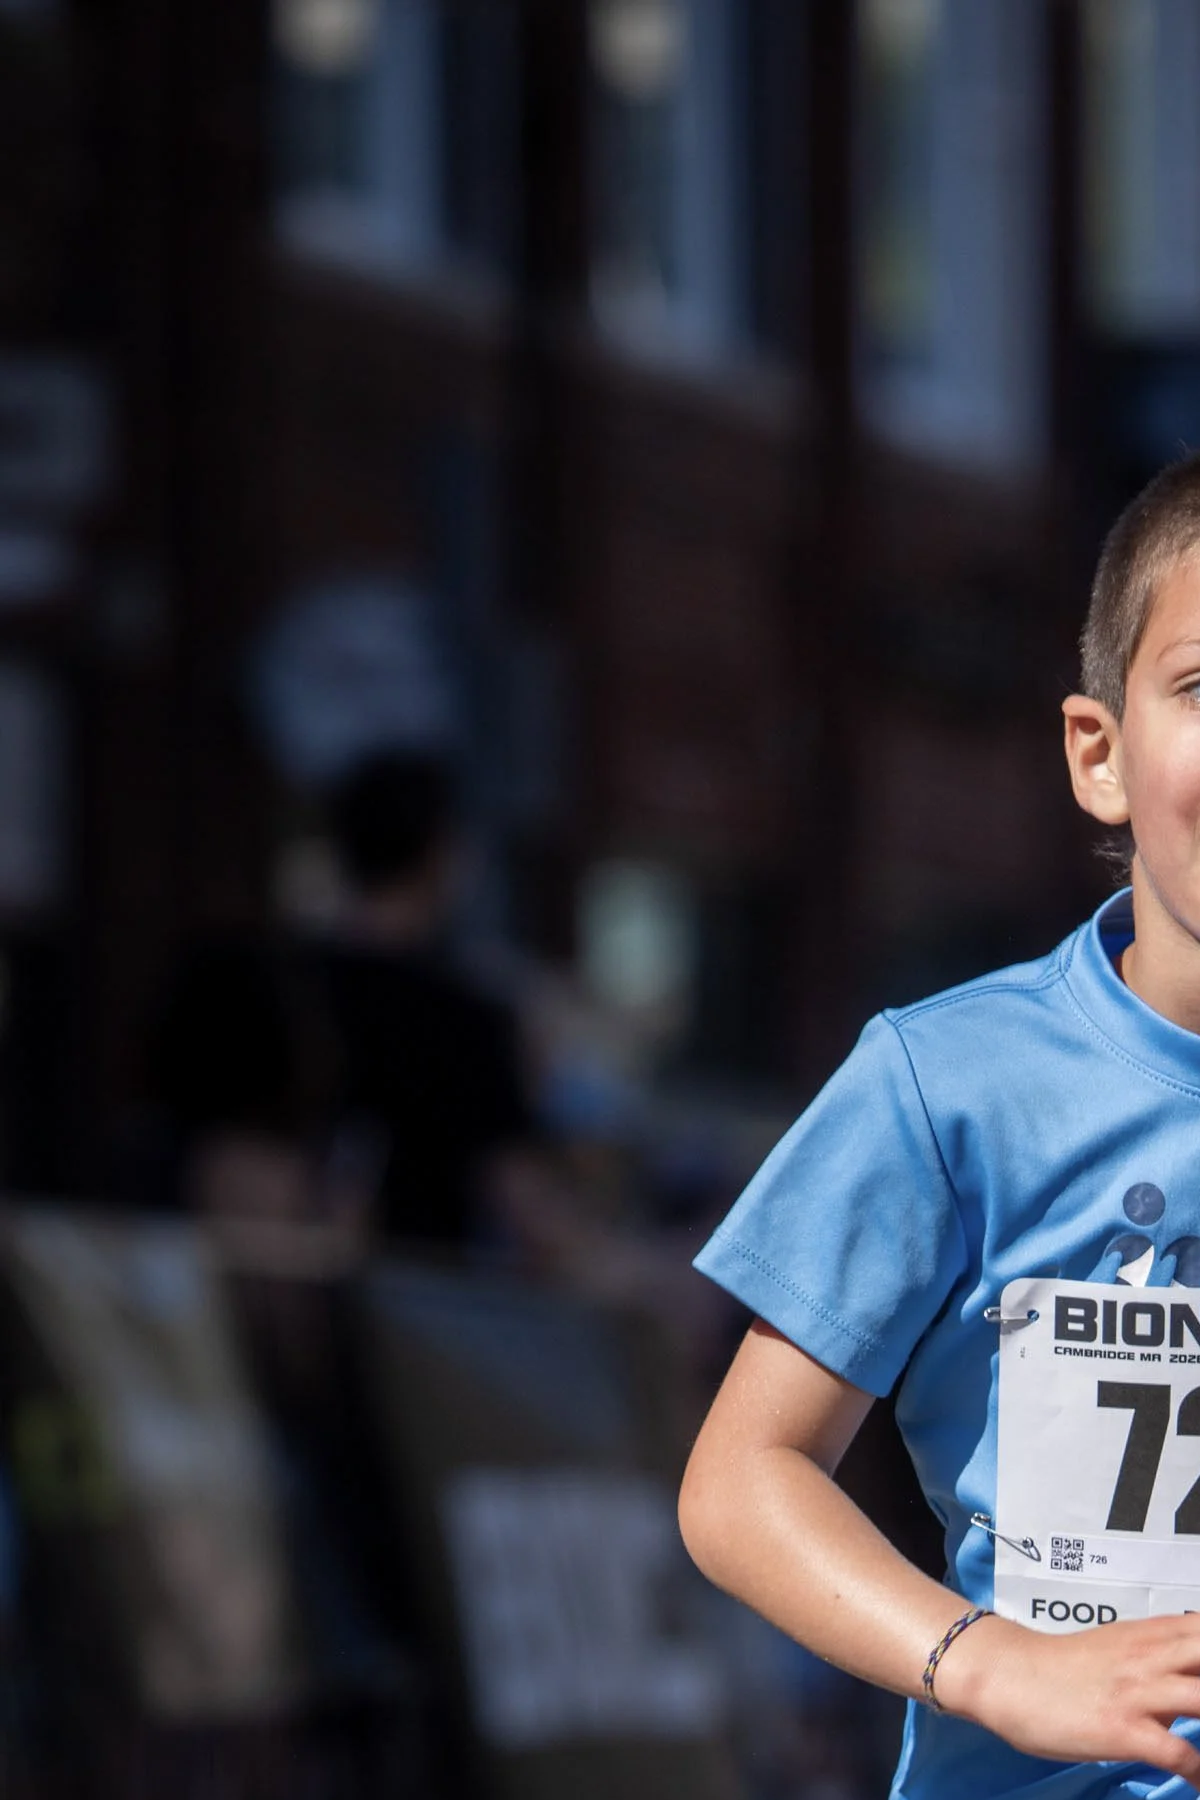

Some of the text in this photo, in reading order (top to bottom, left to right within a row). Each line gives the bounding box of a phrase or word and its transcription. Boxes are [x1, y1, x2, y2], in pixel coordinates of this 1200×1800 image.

[1054, 1346, 1136, 1361] CAMBRIDGE
[1140, 1353, 1162, 1362] MA
[1089, 1554, 1108, 1565] 726
[1031, 1598, 1118, 1625] FOOD
